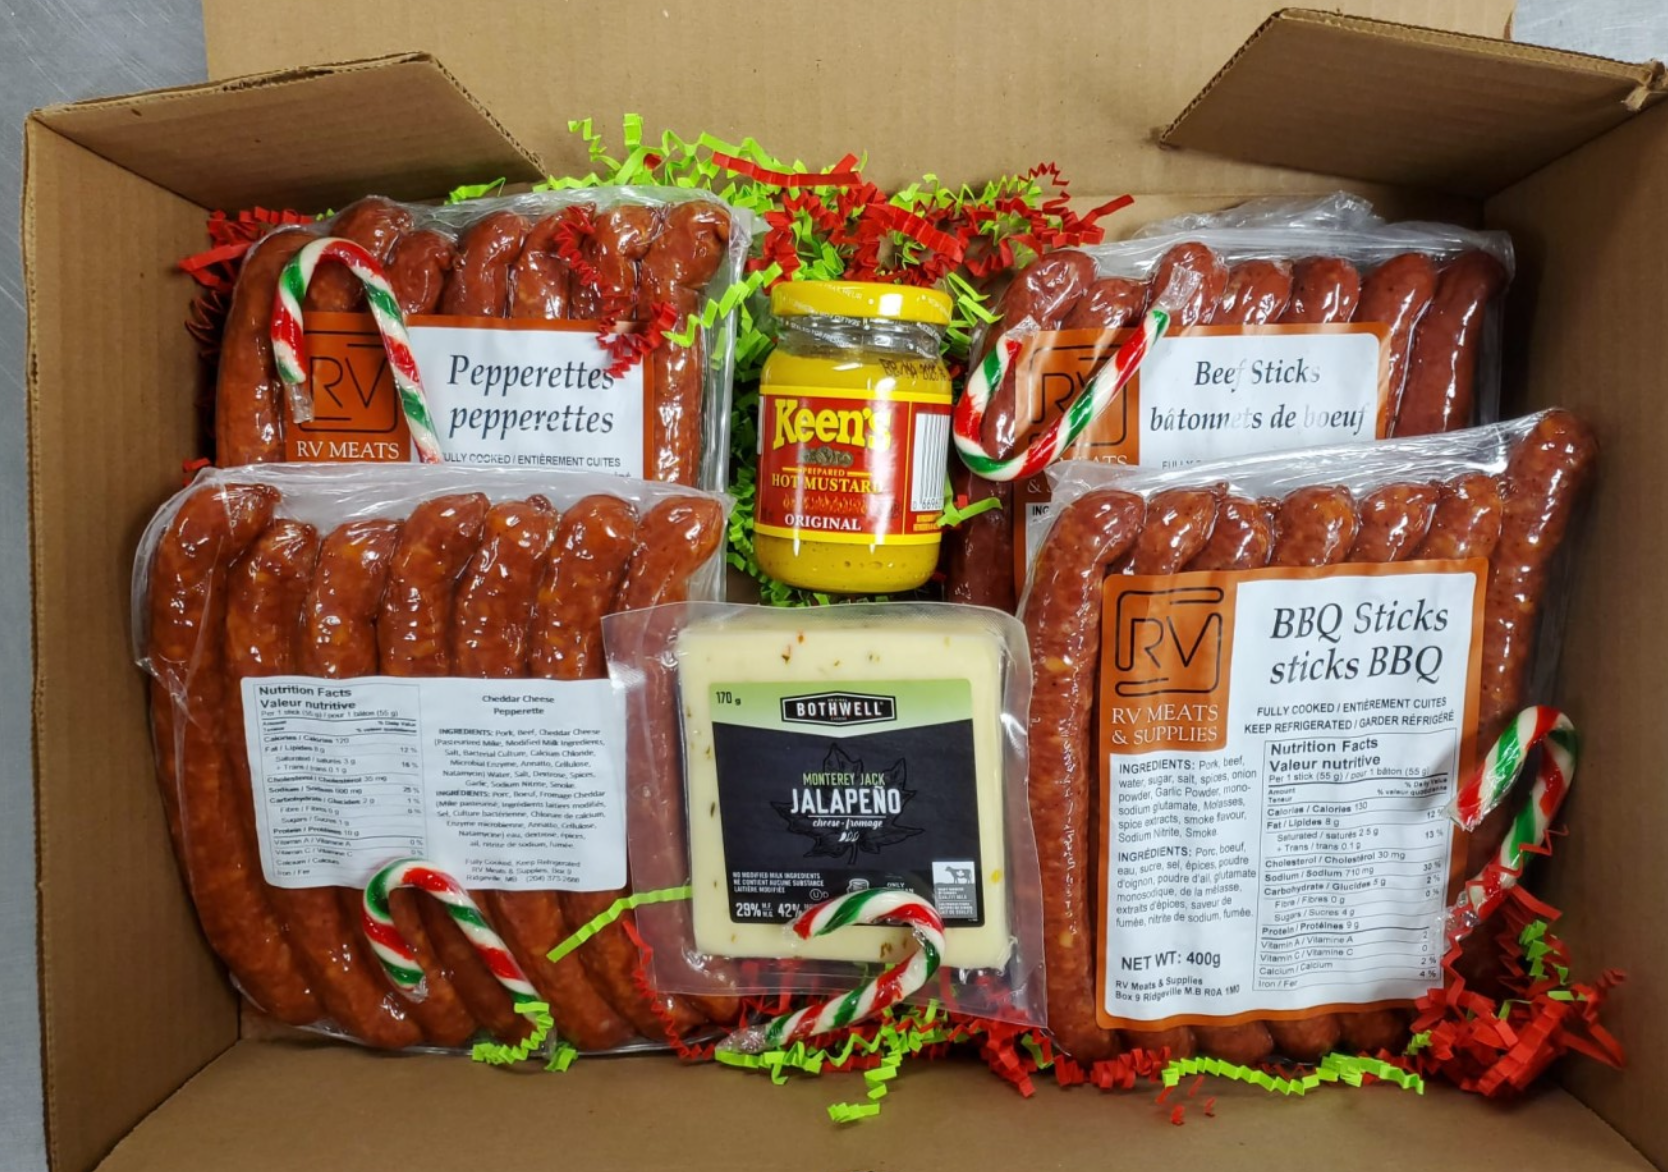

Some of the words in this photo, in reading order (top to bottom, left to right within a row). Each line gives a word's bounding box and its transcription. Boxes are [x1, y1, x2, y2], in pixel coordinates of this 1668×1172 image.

[446, 354, 615, 398] Pepperettes
[1194, 359, 1247, 393] Beef
[1251, 358, 1321, 385] Sticks
[448, 406, 614, 441] pepperettes
[772, 398, 892, 451] Keen's
[1270, 404, 1296, 430] de
[1304, 404, 1371, 437] boeuf
[296, 441, 323, 459] RV
[329, 442, 400, 460] MEATS
[442, 452, 468, 463] ULLY
[469, 454, 511, 465] COOKED
[772, 473, 799, 489] HOT
[785, 514, 862, 531] ORIGINAL
[1270, 602, 1344, 643] BBQ
[1353, 598, 1449, 635] Sticks
[1270, 647, 1359, 685] sticks
[1367, 644, 1444, 685] BBQ
[259, 686, 314, 697] Nutrition
[318, 687, 352, 698] Facts
[482, 695, 520, 703] Cheddar
[522, 695, 555, 704] Cheese
[716, 692, 733, 705] 170
[734, 698, 742, 706] g
[260, 699, 302, 709] Valeur
[306, 700, 356, 710] nutritive
[494, 708, 545, 717] Pepperette
[796, 702, 882, 717] BOTHWELL
[1257, 706, 1290, 717] FULLY
[1292, 703, 1335, 715] COOKED
[1413, 696, 1447, 709] CUITES
[1112, 708, 1142, 725] RV
[1148, 704, 1219, 723] MEATS
[1244, 723, 1272, 734] KEEP
[1274, 720, 1352, 734] REFRIGERATED
[1359, 715, 1399, 729] GARDER
[1402, 710, 1454, 726] RÉFRIGÉRÉ
[1112, 730, 1129, 745] &
[1133, 726, 1218, 745] SUPPLIES
[1270, 740, 1336, 756] Nutrition
[1342, 738, 1378, 752] Facts
[1119, 759, 1195, 775] INGREDIENTS:
[1198, 760, 1220, 771] Pork,
[1223, 755, 1245, 767] beef,
[1270, 758, 1318, 772] Valeur
[1322, 754, 1381, 770] nutritive
[802, 772, 855, 786] MONTEREY
[860, 772, 886, 786] JACK
[1148, 774, 1174, 786] sugar,
[1178, 774, 1197, 785] salt,
[1232, 769, 1257, 780] onion
[790, 786, 901, 814] JALAPEÑO
[1118, 791, 1153, 804] powder,
[1155, 786, 1182, 797] Garlic
[1184, 786, 1221, 798] Powder,
[1224, 784, 1251, 794] mono-
[1118, 805, 1150, 816] sodium
[1152, 801, 1200, 814] glutamate,
[1267, 806, 1304, 817] Calories
[1312, 804, 1351, 814] Calories
[1118, 820, 1143, 832] spice
[1184, 814, 1215, 825] smoke
[1266, 821, 1281, 830] Fat
[1288, 818, 1322, 829] Lipides
[1118, 831, 1151, 844] Sodium
[1154, 828, 1182, 839] Nitrite,
[1118, 846, 1192, 862] INGRÉDIENTS:
[1220, 842, 1246, 854] boeuf,
[1118, 866, 1138, 877] eau,
[1140, 864, 1164, 874] sucre,
[1219, 856, 1249, 868] poudre
[1264, 872, 1299, 883] Sodium
[1306, 868, 1343, 878] Sodium
[1158, 874, 1189, 885] poudre
[1214, 869, 1257, 883] glutamate
[1180, 888, 1192, 897] de
[1194, 888, 1203, 897] la
[735, 902, 762, 918] 29%
[1116, 903, 1148, 915] extraits
[1191, 900, 1220, 911] saveur
[1221, 896, 1233, 906] de
[1148, 914, 1172, 925] nitrite
[1174, 912, 1185, 922] de
[1188, 910, 1222, 924] sodium,
[1224, 907, 1254, 919] fumée.
[1121, 956, 1152, 971] NET
[1155, 950, 1182, 968] WT:
[1186, 952, 1221, 969] 400g
[1116, 980, 1129, 990] RV
[1132, 981, 1156, 991] Meats
[1166, 976, 1203, 987] Supplies
[1116, 990, 1132, 1001] Box
[1135, 993, 1141, 1002] 9
[1143, 986, 1182, 1002] Ridgeville
